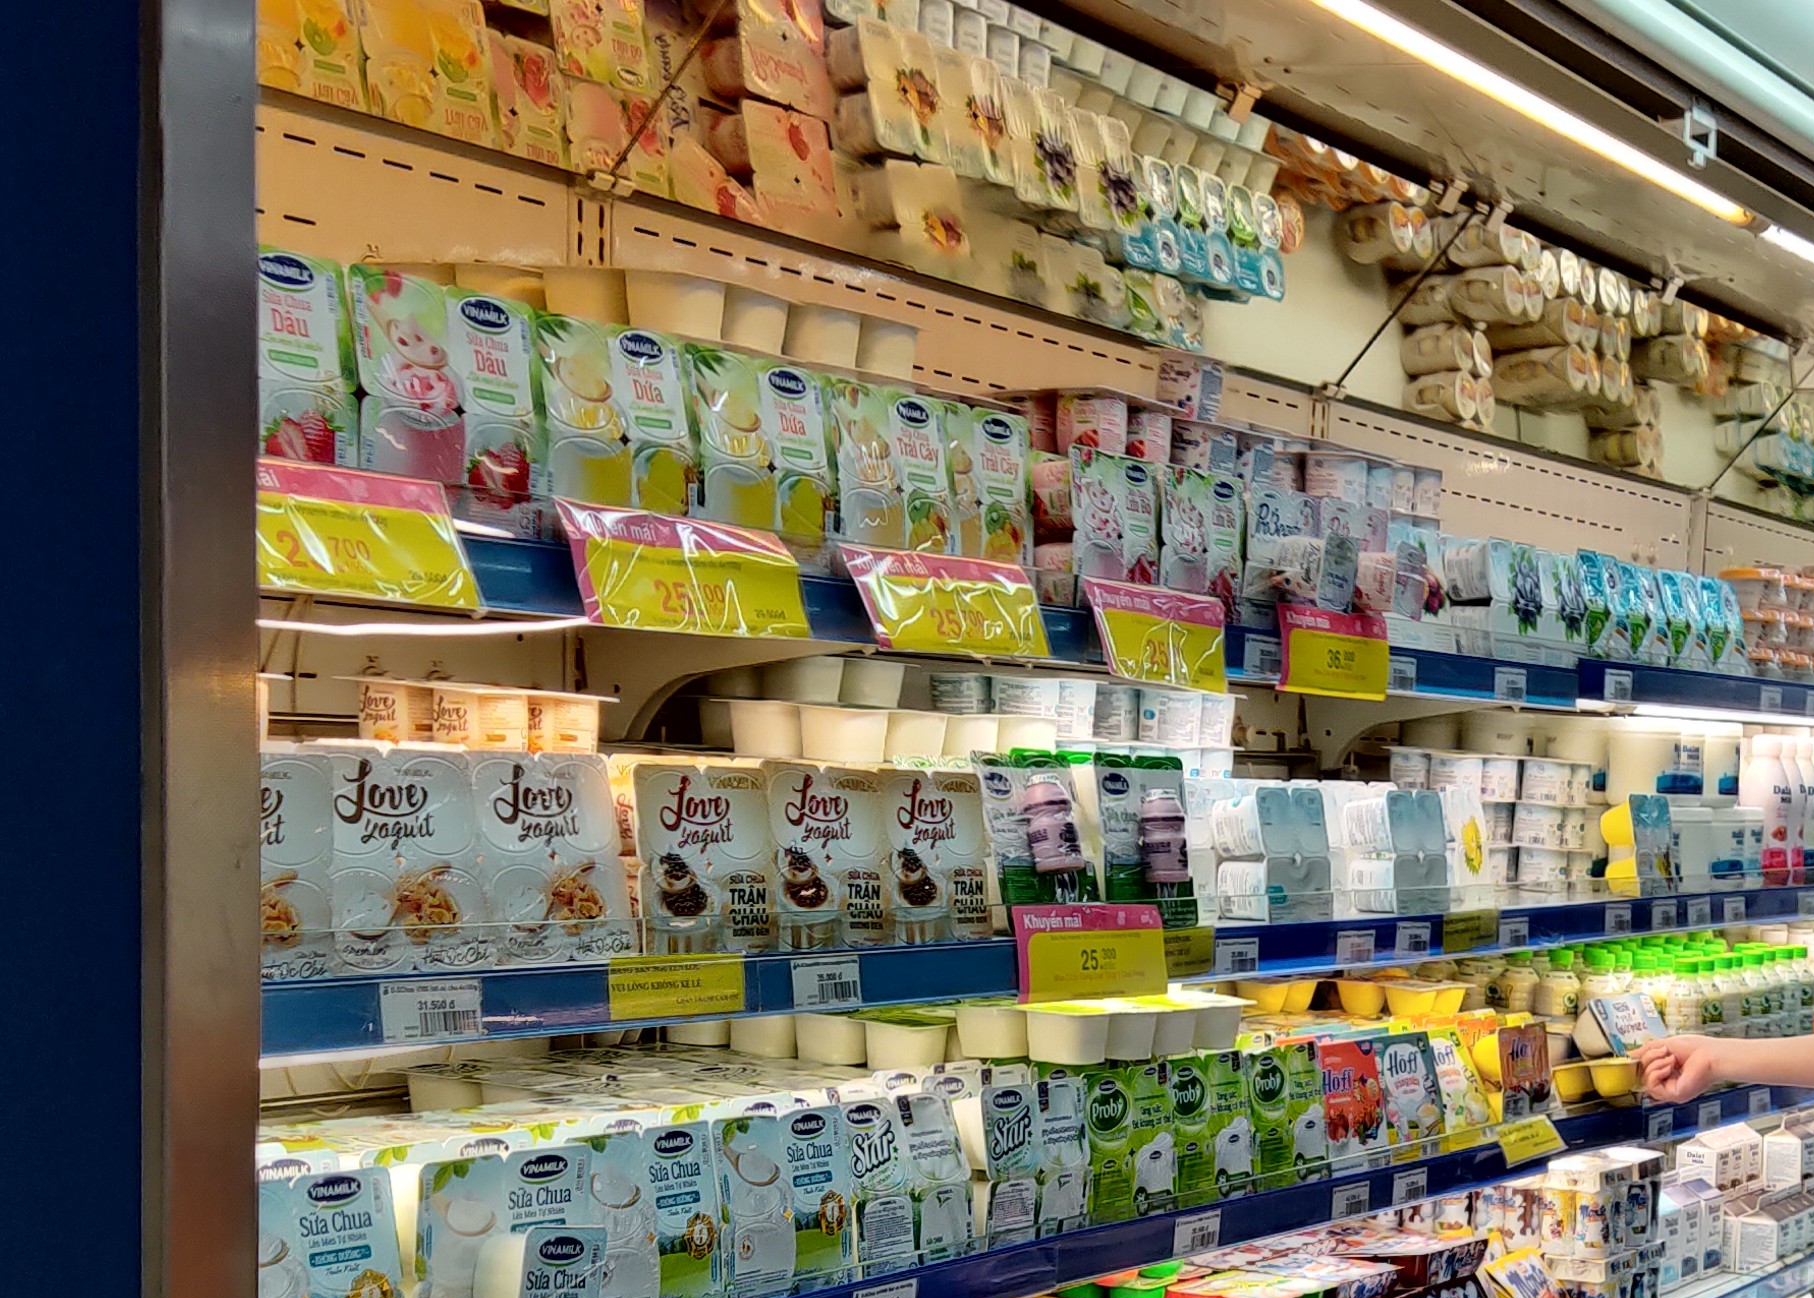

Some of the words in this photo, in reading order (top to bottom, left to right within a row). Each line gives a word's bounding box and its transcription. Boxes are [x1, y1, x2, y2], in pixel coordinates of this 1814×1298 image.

[271, 306, 310, 338] Dâu
[460, 300, 511, 331] VINAMILK
[620, 336, 662, 357] VINAMILK
[473, 346, 508, 378] Dâu
[633, 377, 665, 405] Dứa
[770, 373, 806, 394] VINAMILK
[779, 412, 806, 436] Dứa
[257, 467, 281, 489] ãi
[630, 522, 657, 542] mãi
[333, 758, 428, 825] Love
[493, 763, 573, 825] Love
[784, 773, 848, 828] Love
[659, 774, 730, 834] Love
[896, 778, 952, 831] Love
[360, 810, 435, 850] yogurt
[517, 810, 581, 854] yogurt
[680, 819, 735, 861] yogurt
[800, 816, 854, 857] yogurt
[912, 816, 957, 857] yogurt
[729, 882, 767, 906] TRÂN
[847, 878, 881, 900] TRÂN
[953, 876, 984, 897] TRÂN
[729, 903, 769, 926] CHÂU
[1023, 911, 1062, 931] Khuyến
[1064, 914, 1082, 929] mãi
[1172, 1083, 1199, 1105] Proby
[1255, 1075, 1280, 1094] Proby
[849, 1108, 880, 1120] VINAMILK
[1092, 1097, 1123, 1122] Proby
[792, 1120, 825, 1132] VINAMILK
[991, 1105, 1031, 1161] Star
[654, 1134, 693, 1152] VINAMILK
[655, 1136, 692, 1150] VINAMILK
[786, 1143, 804, 1163] Sữa
[807, 1143, 833, 1158] Chua
[852, 1119, 895, 1179] Star
[522, 1158, 567, 1175] VINAMILK
[648, 1160, 670, 1185] Sữa
[671, 1158, 702, 1182] Chua
[649, 1162, 669, 1183] Sữa
[672, 1160, 701, 1179] Chua
[309, 1181, 359, 1198] VINAMILK
[508, 1187, 533, 1210] Sữa
[536, 1187, 572, 1205] Chua
[300, 1212, 329, 1238] Sữa
[332, 1211, 373, 1232] Chua
[542, 1244, 582, 1256] VINAMILK
[526, 1268, 550, 1291] Sữa
[553, 1269, 586, 1290] Chua
